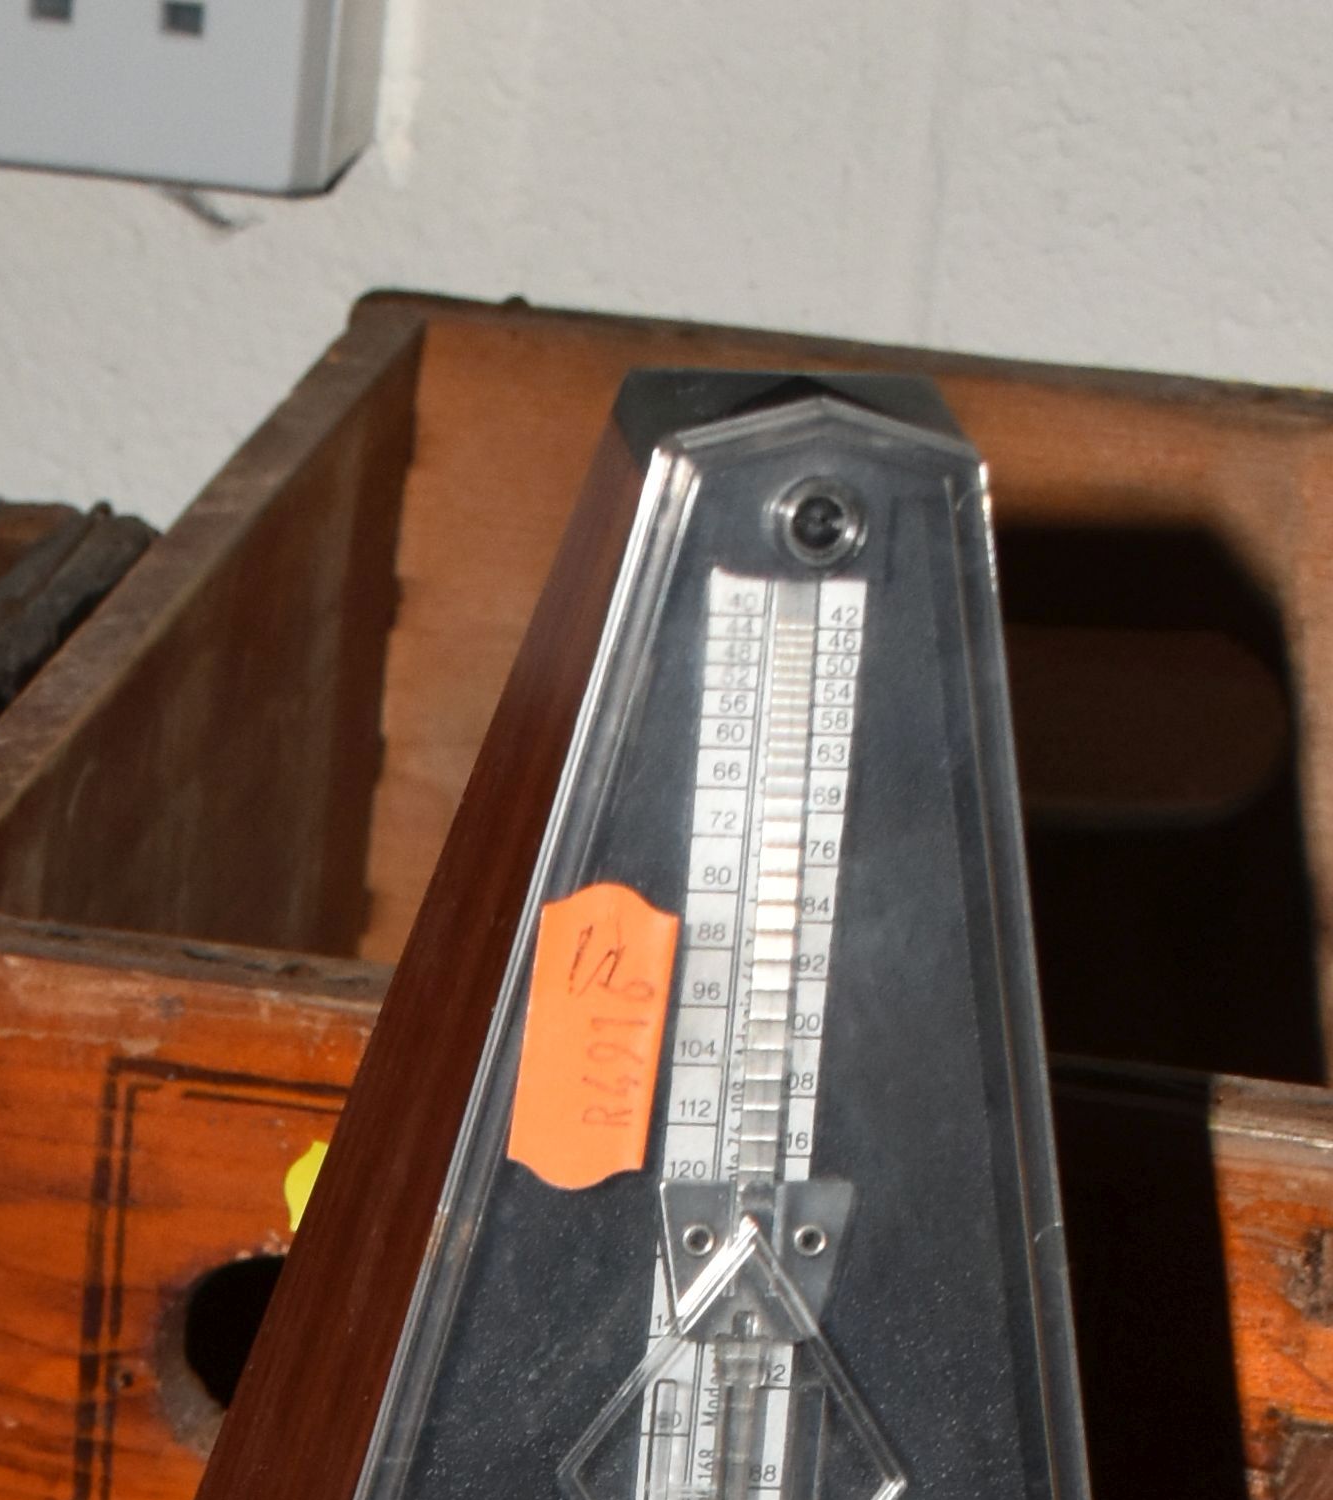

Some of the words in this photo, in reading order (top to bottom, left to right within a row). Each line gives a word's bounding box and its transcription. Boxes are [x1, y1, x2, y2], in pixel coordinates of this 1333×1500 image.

[831, 607, 858, 623] 42
[828, 631, 856, 650] 46
[825, 657, 854, 677] 50
[823, 683, 850, 702] 54
[719, 694, 748, 713] 56
[820, 711, 848, 730] 58
[716, 723, 745, 743] 60
[817, 743, 845, 763] 63
[713, 762, 741, 781] 66
[813, 787, 841, 806] 69
[710, 811, 737, 830] 72
[809, 840, 836, 860] 76
[703, 866, 731, 885] 80
[802, 897, 830, 915] 84
[697, 923, 726, 942] 88
[798, 954, 826, 973] 92
[693, 981, 721, 1000] 96
[792, 1013, 821, 1032] 00
[680, 1040, 716, 1058] 104
[788, 1072, 815, 1090] 08
[678, 1099, 712, 1118] 112
[787, 1132, 810, 1150] 16
[669, 1160, 707, 1180] 120
